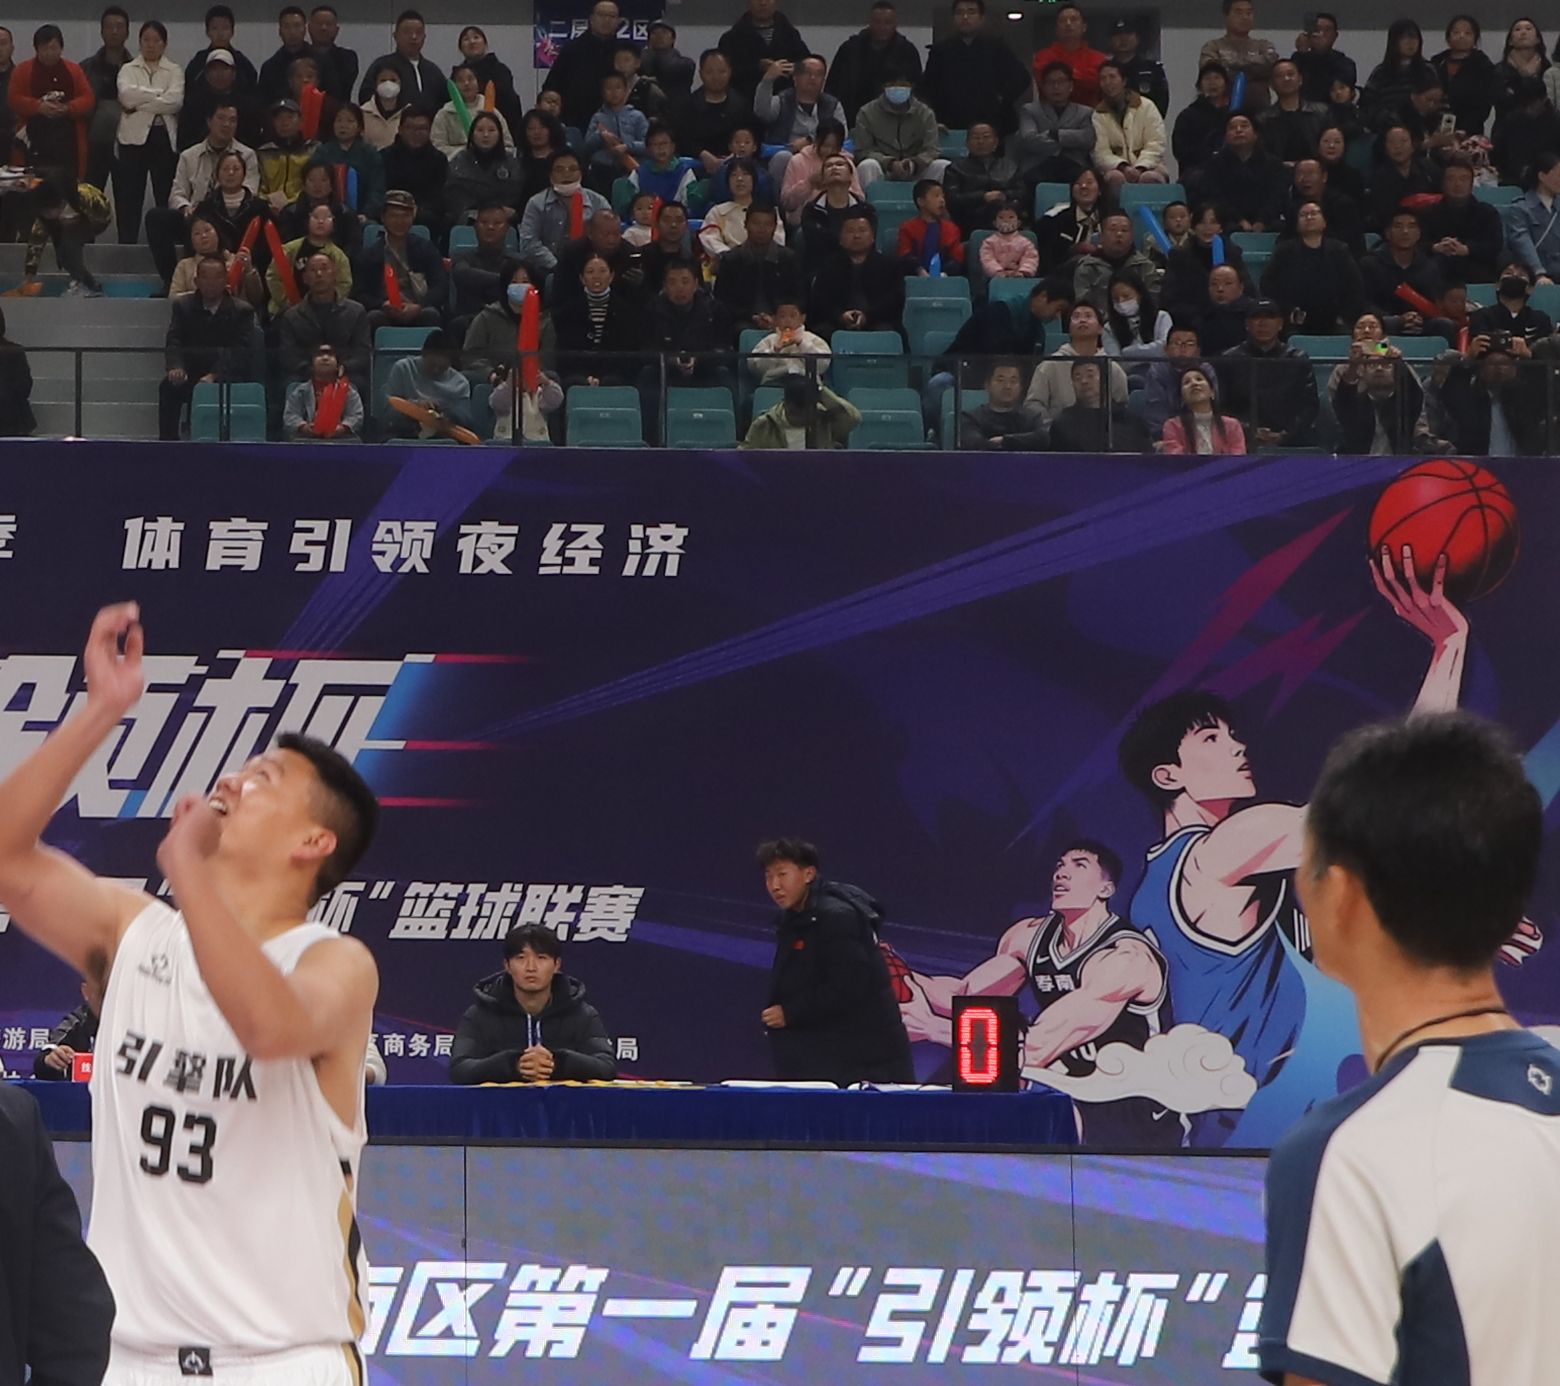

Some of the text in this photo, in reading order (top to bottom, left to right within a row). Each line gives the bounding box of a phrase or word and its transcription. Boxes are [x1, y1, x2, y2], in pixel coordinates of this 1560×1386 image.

[121, 515, 690, 578] 体育引领夜经济
[116, 1029, 258, 1101] 引擎队
[959, 1007, 999, 1085] 0
[139, 1104, 218, 1185] 93
